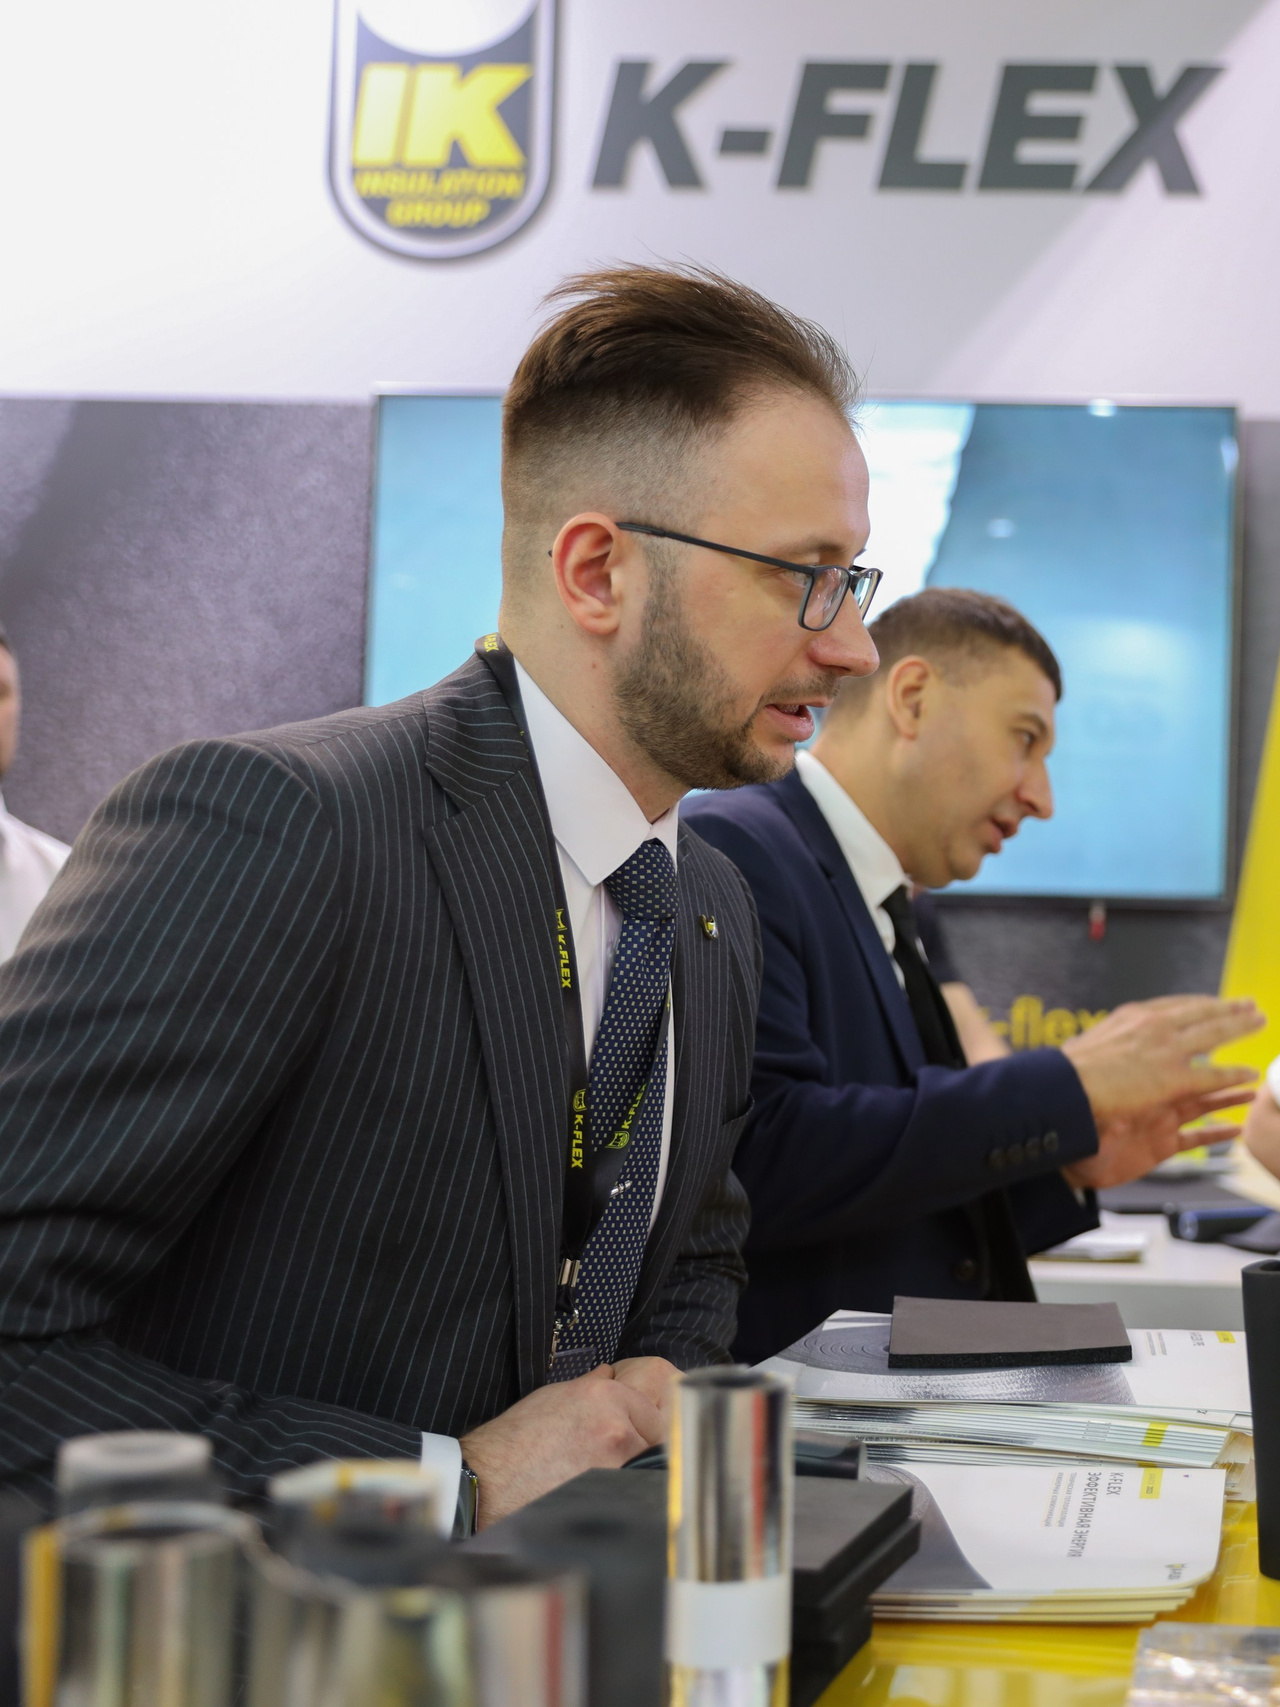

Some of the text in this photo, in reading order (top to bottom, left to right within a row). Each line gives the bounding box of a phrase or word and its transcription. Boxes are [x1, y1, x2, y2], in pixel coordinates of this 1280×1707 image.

[591, 58, 1226, 196] K-FLEX
[558, 934, 571, 989] K-FLEX
[571, 1114, 584, 1169] K-FLEX
[1106, 1472, 1124, 1496] K-FLEX
[1066, 1472, 1102, 1558] ЭФФЕКТИВНАЯ ЭНЕРГИЯ
